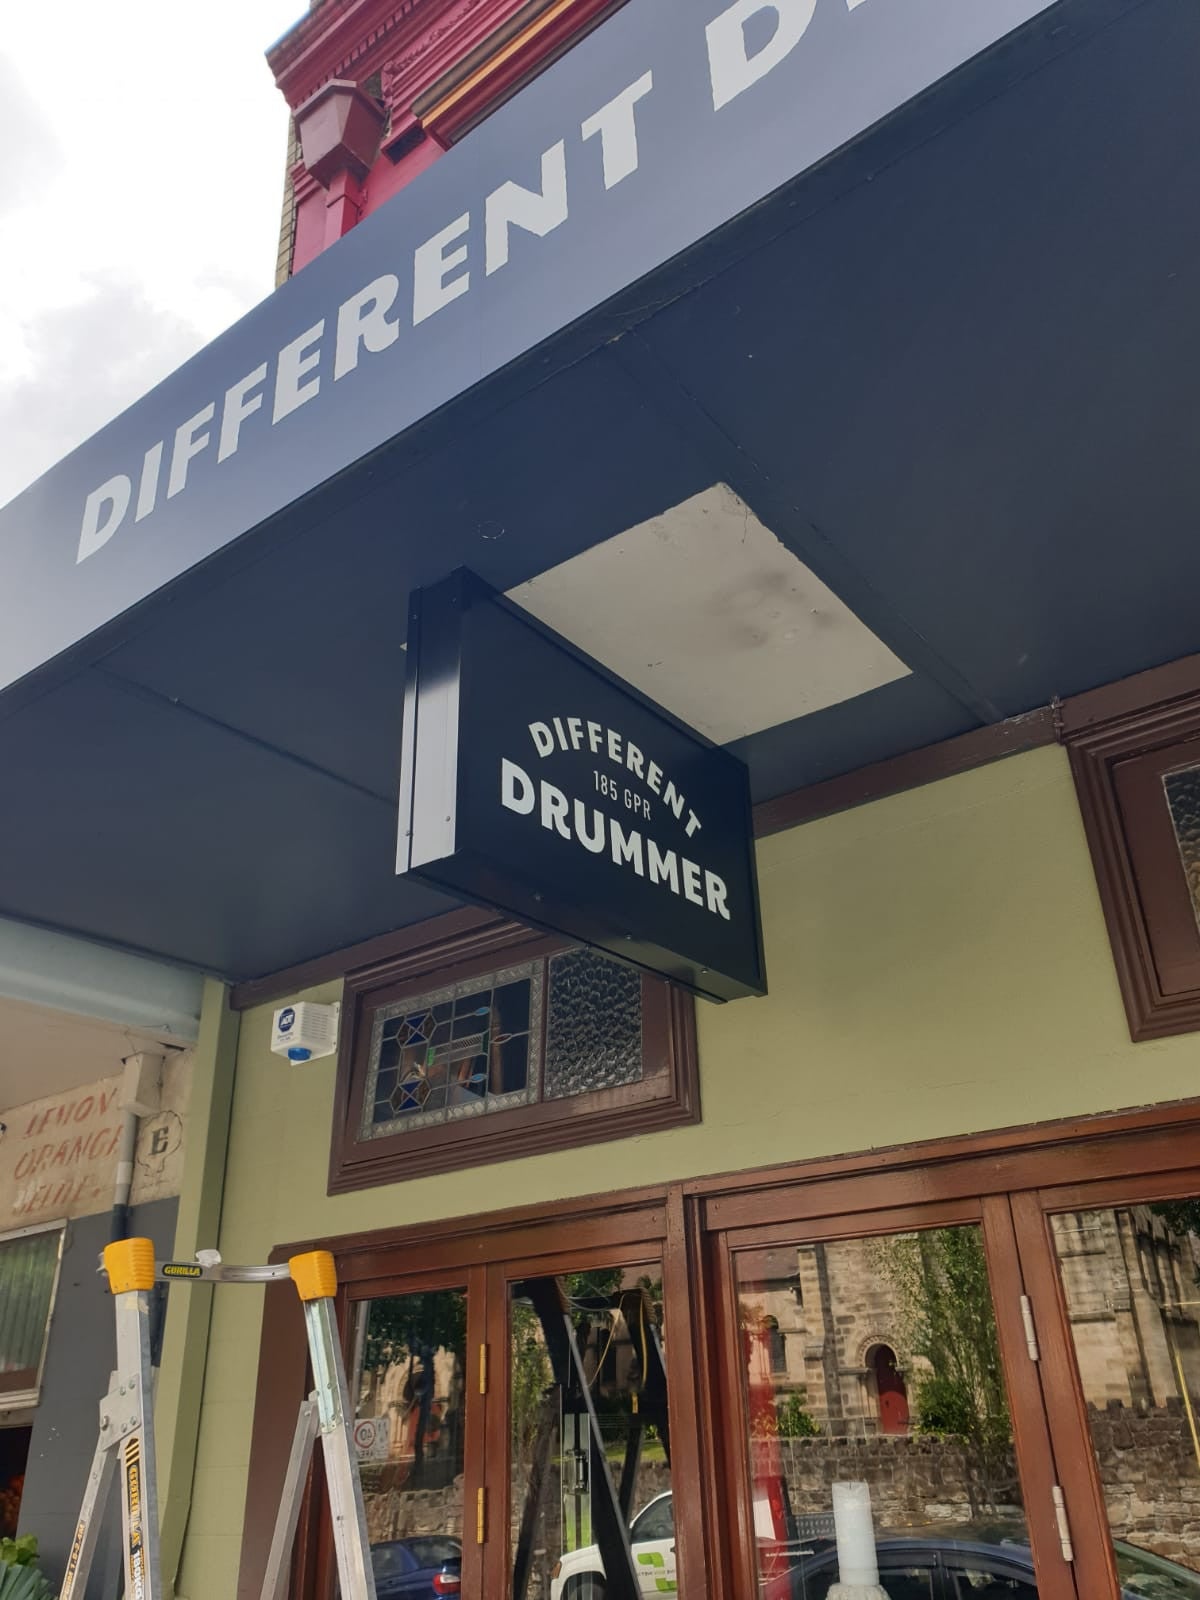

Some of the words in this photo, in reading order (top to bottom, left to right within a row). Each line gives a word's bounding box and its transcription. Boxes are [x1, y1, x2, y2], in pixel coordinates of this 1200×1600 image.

[75, 70, 653, 565] DIFFERENT
[705, 0, 866, 112] D
[501, 757, 731, 921] DRUMMER
[528, 716, 702, 838] DIFFERENT
[593, 770, 618, 801] 185
[624, 788, 651, 821] GPR
